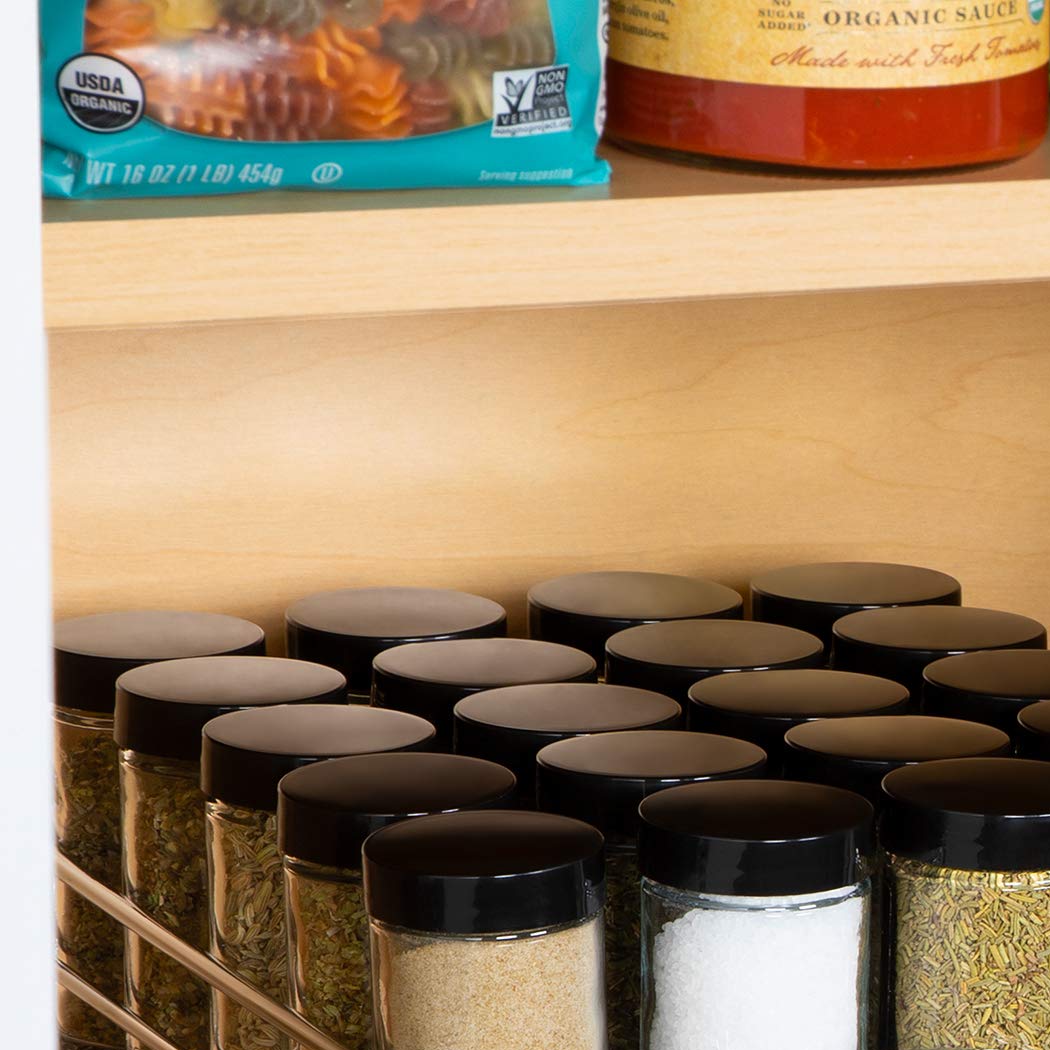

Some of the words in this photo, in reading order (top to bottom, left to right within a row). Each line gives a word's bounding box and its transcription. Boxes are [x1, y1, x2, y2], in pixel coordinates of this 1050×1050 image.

[757, 9, 806, 19] SUGAR
[823, 9, 947, 26] ORGANIC
[955, 1, 1018, 22] SAUCE
[770, 45, 850, 68] Made
[855, 48, 920, 68] with
[924, 43, 980, 68] Fresh
[75, 71, 125, 95] USDA
[538, 70, 567, 84] NON
[535, 81, 565, 96] GMO
[70, 93, 134, 115] ORGANIC
[500, 106, 568, 125] VERIFIED
[86, 160, 117, 185] WT
[122, 164, 145, 184] 16
[147, 164, 175, 184] OZ
[176, 164, 198, 184] (1
[201, 164, 235, 184] LB)
[237, 163, 284, 187] 454g
